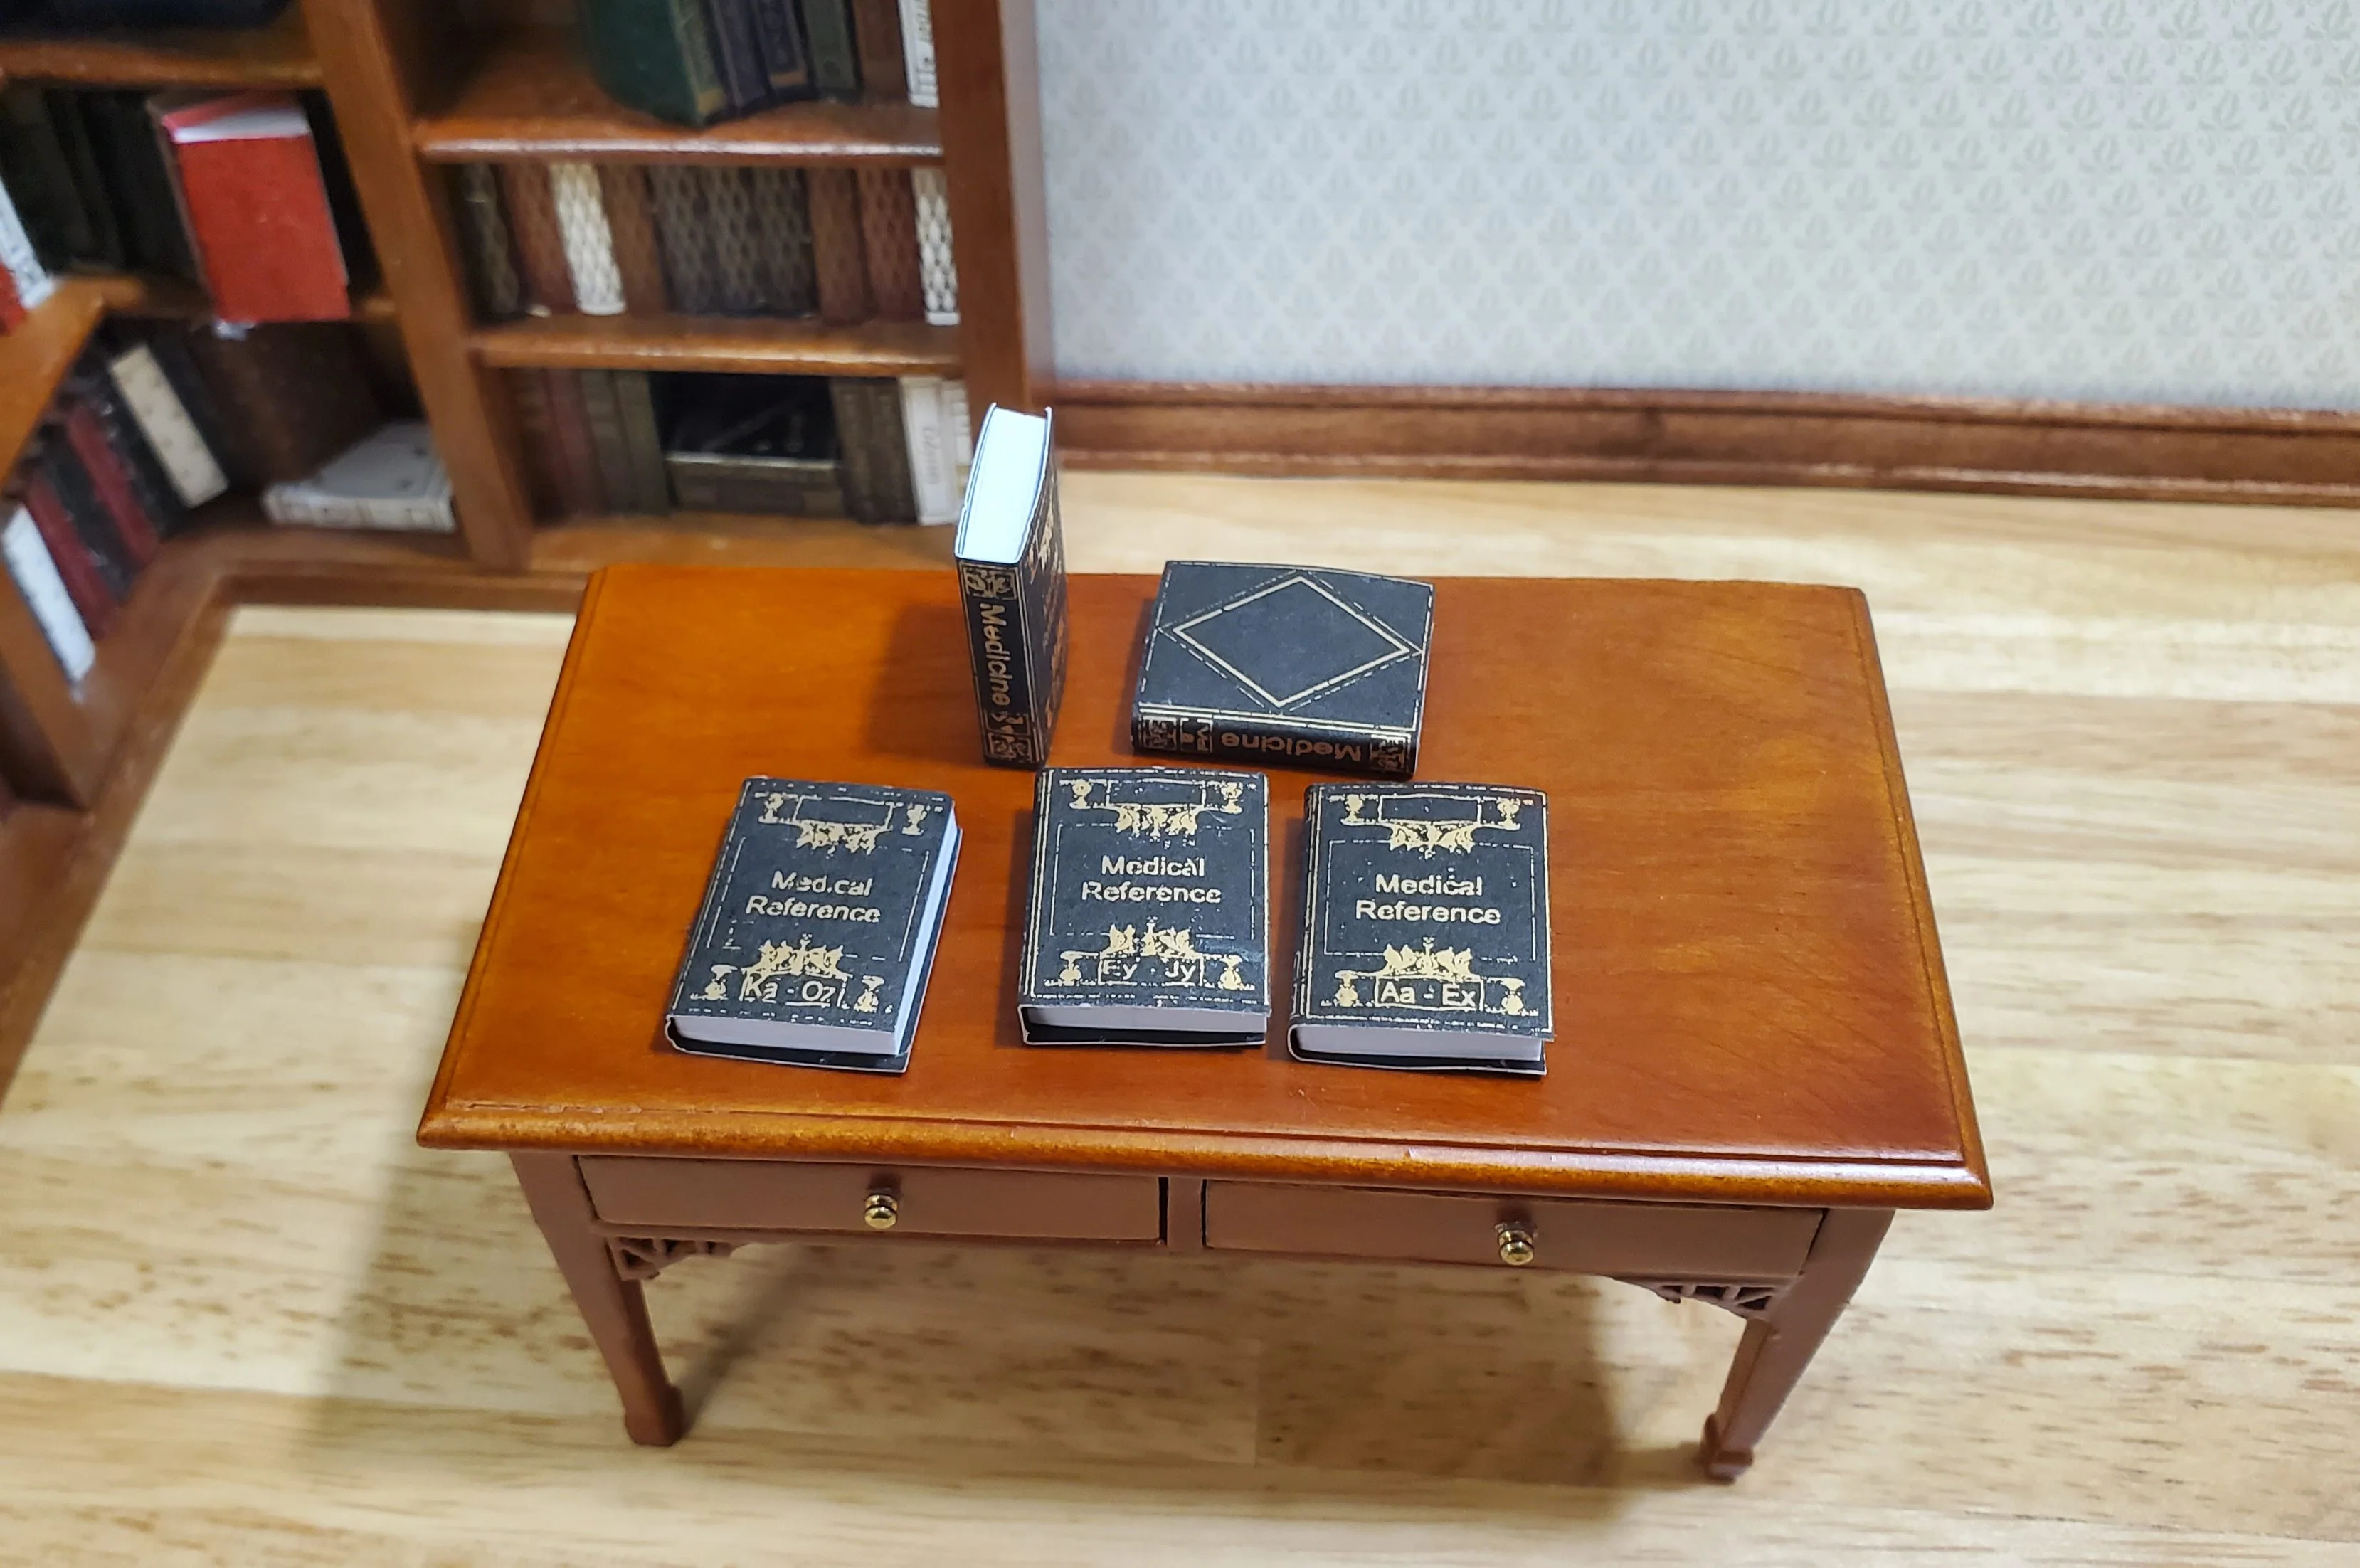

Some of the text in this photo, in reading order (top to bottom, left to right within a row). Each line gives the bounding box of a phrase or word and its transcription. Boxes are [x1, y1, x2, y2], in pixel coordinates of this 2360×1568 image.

[979, 603, 1013, 706] Medicine
[1221, 732, 1362, 761] Medicine
[1101, 855, 1205, 877] Medical
[1081, 881, 1222, 904] Reference
[1375, 874, 1483, 896] Medical
[746, 895, 881, 923] Reference
[1355, 899, 1501, 924] Reference
[746, 976, 778, 1003] Ka
[1380, 981, 1416, 1005] Aa
[1443, 984, 1476, 1007] Ex
